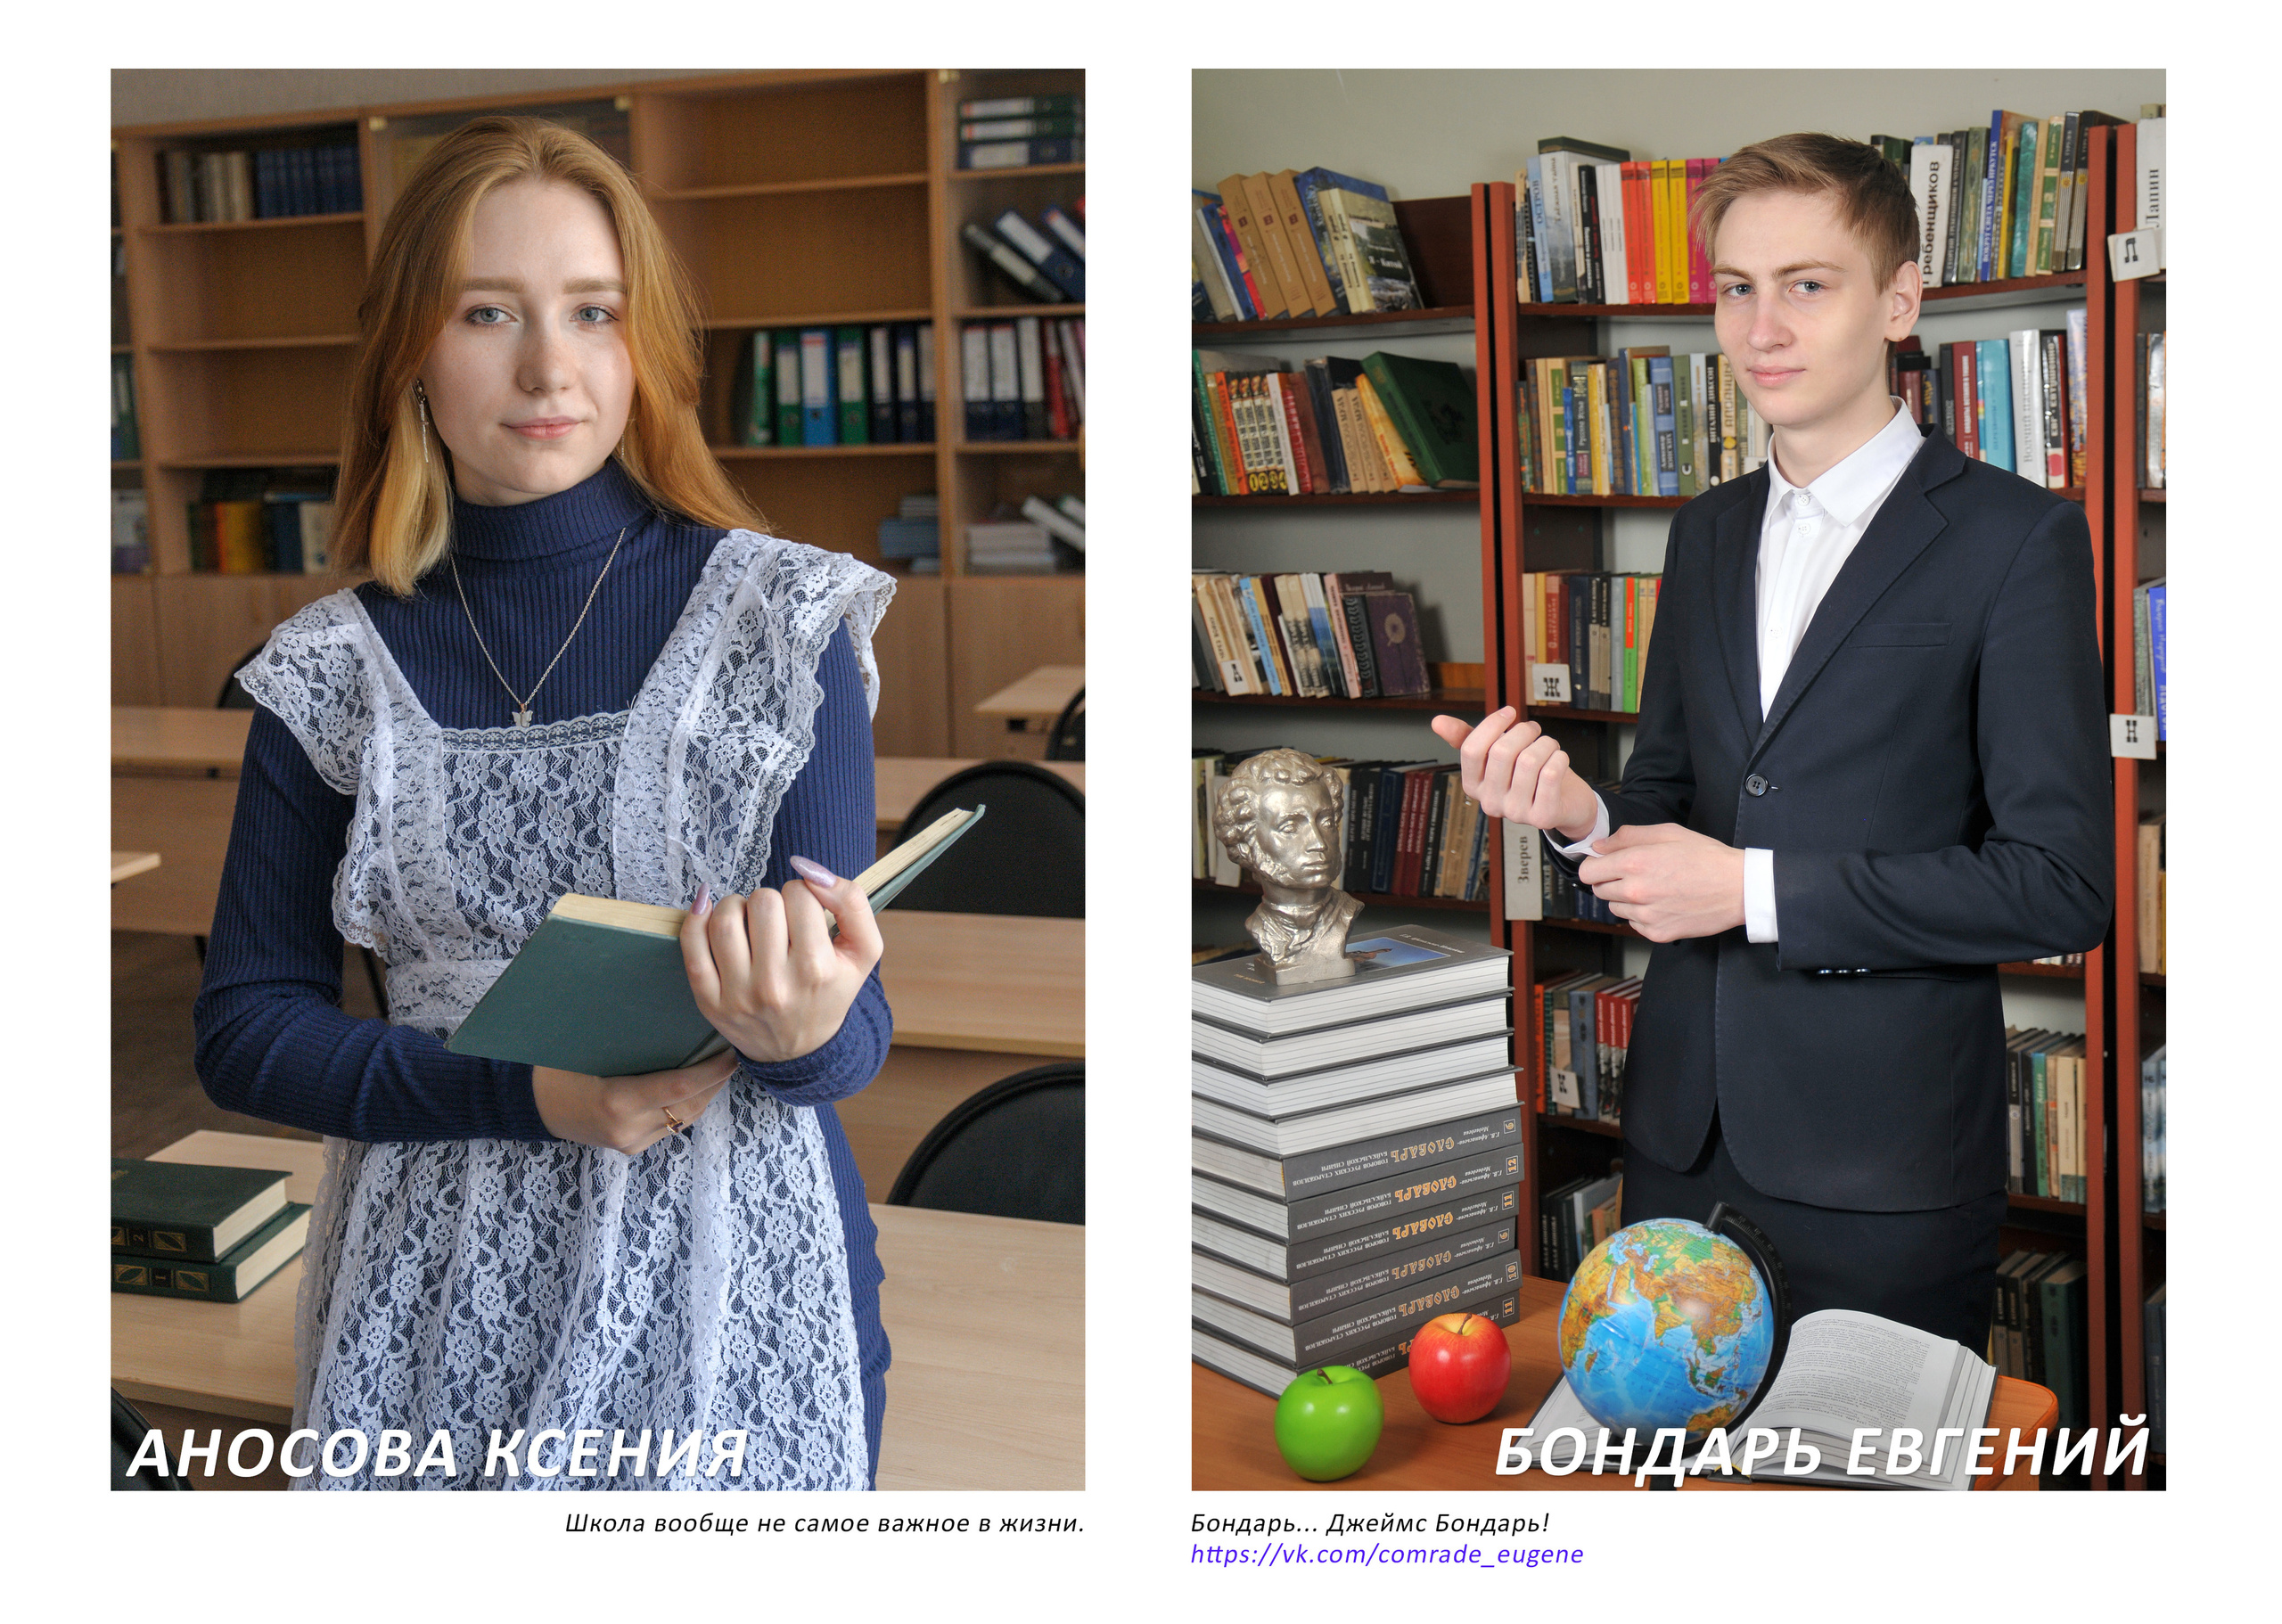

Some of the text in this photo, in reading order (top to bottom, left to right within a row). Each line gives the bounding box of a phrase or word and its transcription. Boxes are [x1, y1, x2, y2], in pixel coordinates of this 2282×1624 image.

[1532, 180, 1543, 224] ОСТРОВ
[2145, 168, 2161, 228] Лапин
[1707, 366, 1717, 443] ВИТАЛИЙ ДИКСОН
[2023, 414, 2032, 463] Волчий
[1543, 677, 1561, 698] Ж
[2125, 719, 2138, 743] Н
[1518, 836, 1532, 883] Зверев
[1463, 1126, 1490, 1136] Медведева
[1490, 1131, 1500, 1139] Г.В.
[1506, 1122, 1514, 1130] 6
[1321, 1152, 1387, 1172] БАЙКАЛЬСКОЙ СИБИРИ
[1391, 1137, 1454, 1163] СЛОВАРЬ
[1293, 1159, 1388, 1185] ГОВОРОВ РУССКИХ СТАРОЖИЛОВ
[1465, 1166, 1490, 1176] Медведева
[1493, 1169, 1502, 1177] Г.В.
[1508, 1159, 1516, 1172] 12
[1395, 1176, 1457, 1202] СЛОВАРЬ
[1504, 1193, 1512, 1207] 11
[1297, 1200, 1391, 1229] ГОВОРОВ РУССКИХ СТАРОЖИЛОВ
[1325, 1193, 1391, 1215] БАЙКАЛЬСКОЙ СИБИРИ
[1462, 1202, 1487, 1212] Медведева
[1392, 1212, 1453, 1240] СЛОВАРЬ
[1296, 1237, 1389, 1269] ГОВОРОВ РУССКИХ СТАРОЖИЛОВ
[1324, 1230, 1389, 1254] БАЙКАЛЬСКОЙ СИБИРИ
[1460, 1237, 1485, 1248] Медведева
[1391, 1251, 1451, 1280] СЛОВАРЬ
[1507, 1265, 1516, 1279] 10
[1326, 1269, 1389, 1294] БАЙКАЛЬСКОЙ СИБИРИ
[1467, 1274, 1493, 1285] Медведева
[1299, 1276, 1389, 1310] ГОВОРОВ РУССКИХ СТАРОЖИЛОВ
[1399, 1285, 1460, 1316] СЛОВАРЬ
[1505, 1301, 1513, 1314] 11
[1305, 1315, 1397, 1351] ГОВОРОВ РУССКИХ СТАРОЖИЛОВ
[1333, 1308, 1396, 1334] БАЙКАЛЬСКОЙ СИБИРИ
[1356, 1347, 1395, 1366] БАЙКАЛЬСКОЙ
[1373, 1354, 1395, 1366] ГОВОРОВ
